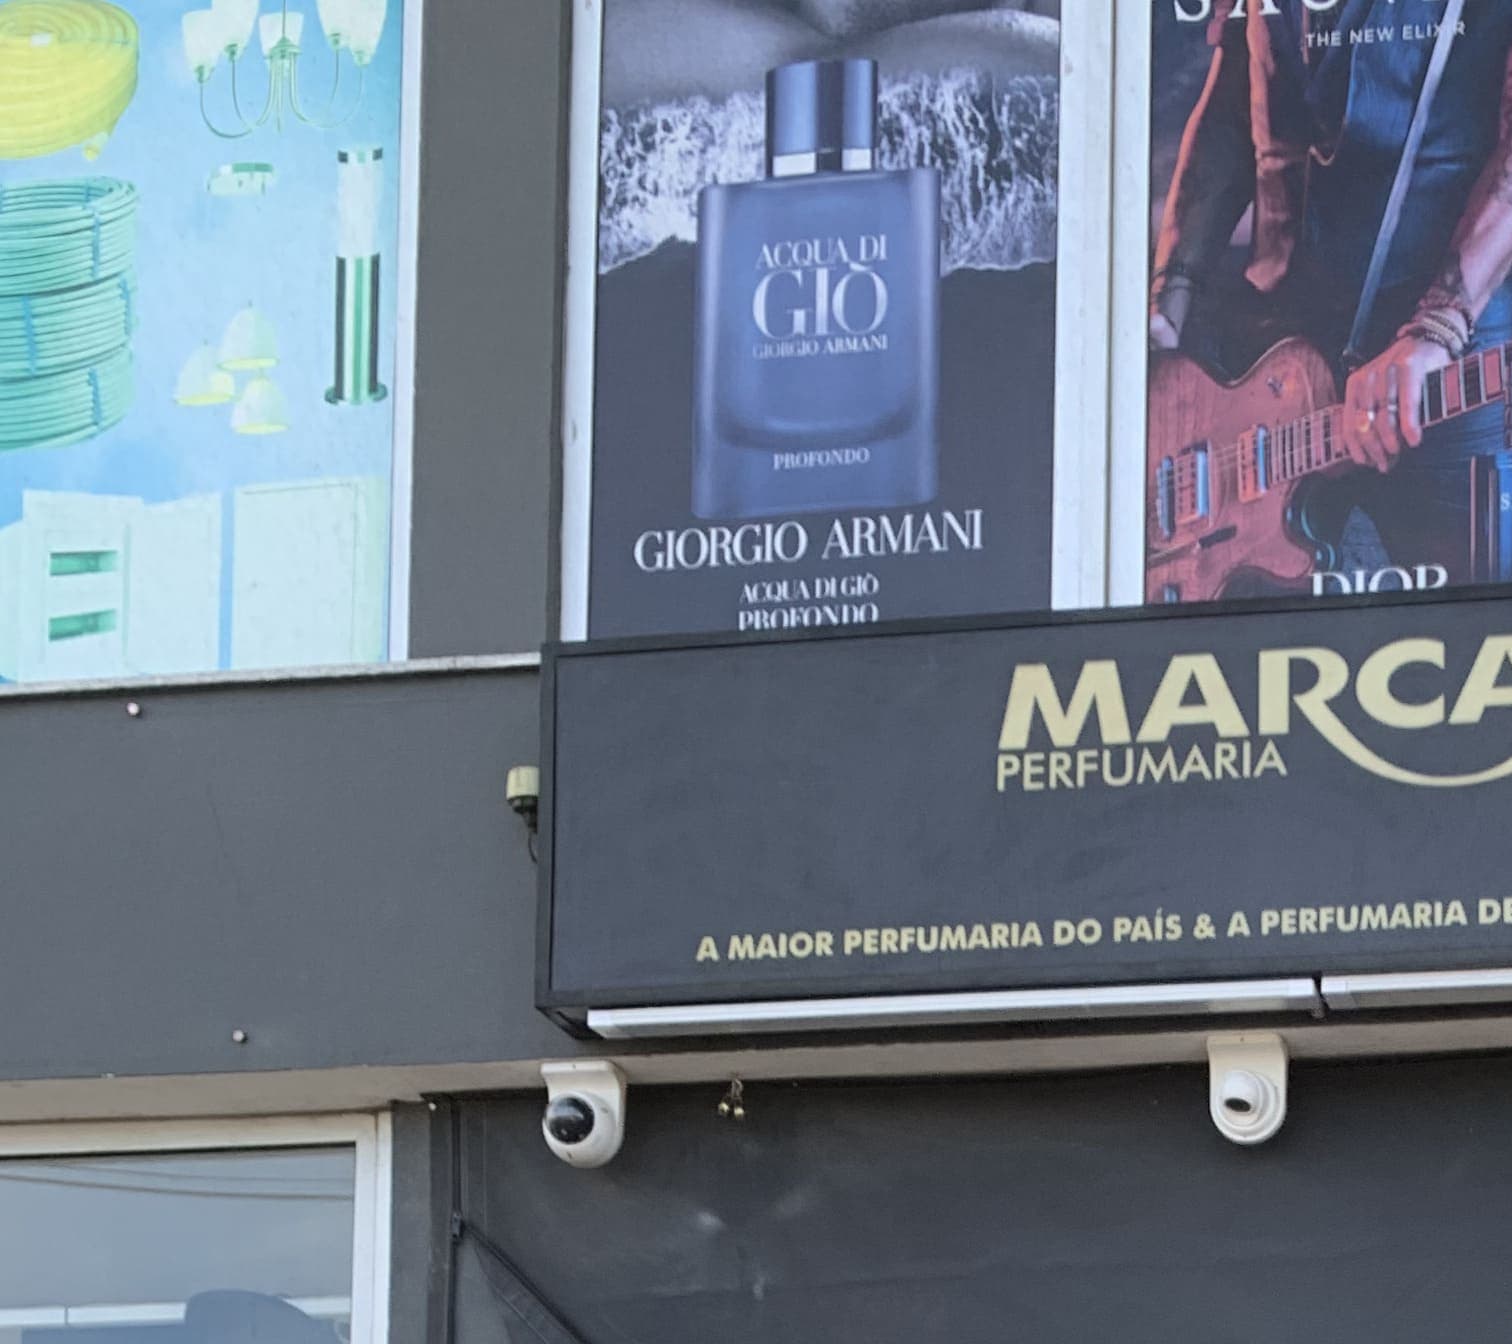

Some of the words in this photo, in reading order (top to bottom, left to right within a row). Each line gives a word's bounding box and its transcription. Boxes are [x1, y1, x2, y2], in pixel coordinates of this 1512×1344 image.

[1305, 30, 1342, 49] THE
[1349, 27, 1395, 45] NEW
[755, 237, 849, 269] ACQUA
[860, 234, 887, 262] DI
[752, 260, 888, 340] GIÒ
[752, 340, 820, 358] GIORGIO
[822, 334, 889, 354] ARMANI
[773, 447, 871, 471] PROFONDO
[633, 525, 808, 572] GIORGIO
[822, 508, 984, 562] ARMANI
[739, 579, 811, 604] ACQUA
[814, 576, 837, 599] DI
[738, 602, 880, 631] PROFONDO
[996, 738, 1288, 793] PERFUMARIA
[696, 936, 720, 962] A
[728, 931, 834, 961] MAIOR
[844, 922, 1044, 957] PERFUMARIA
[1054, 918, 1103, 947] DO
[1112, 908, 1184, 943] PAÍS
[1192, 914, 1217, 940] &
[1226, 910, 1251, 938] A
[1260, 898, 1468, 938] PERFUMARIA
